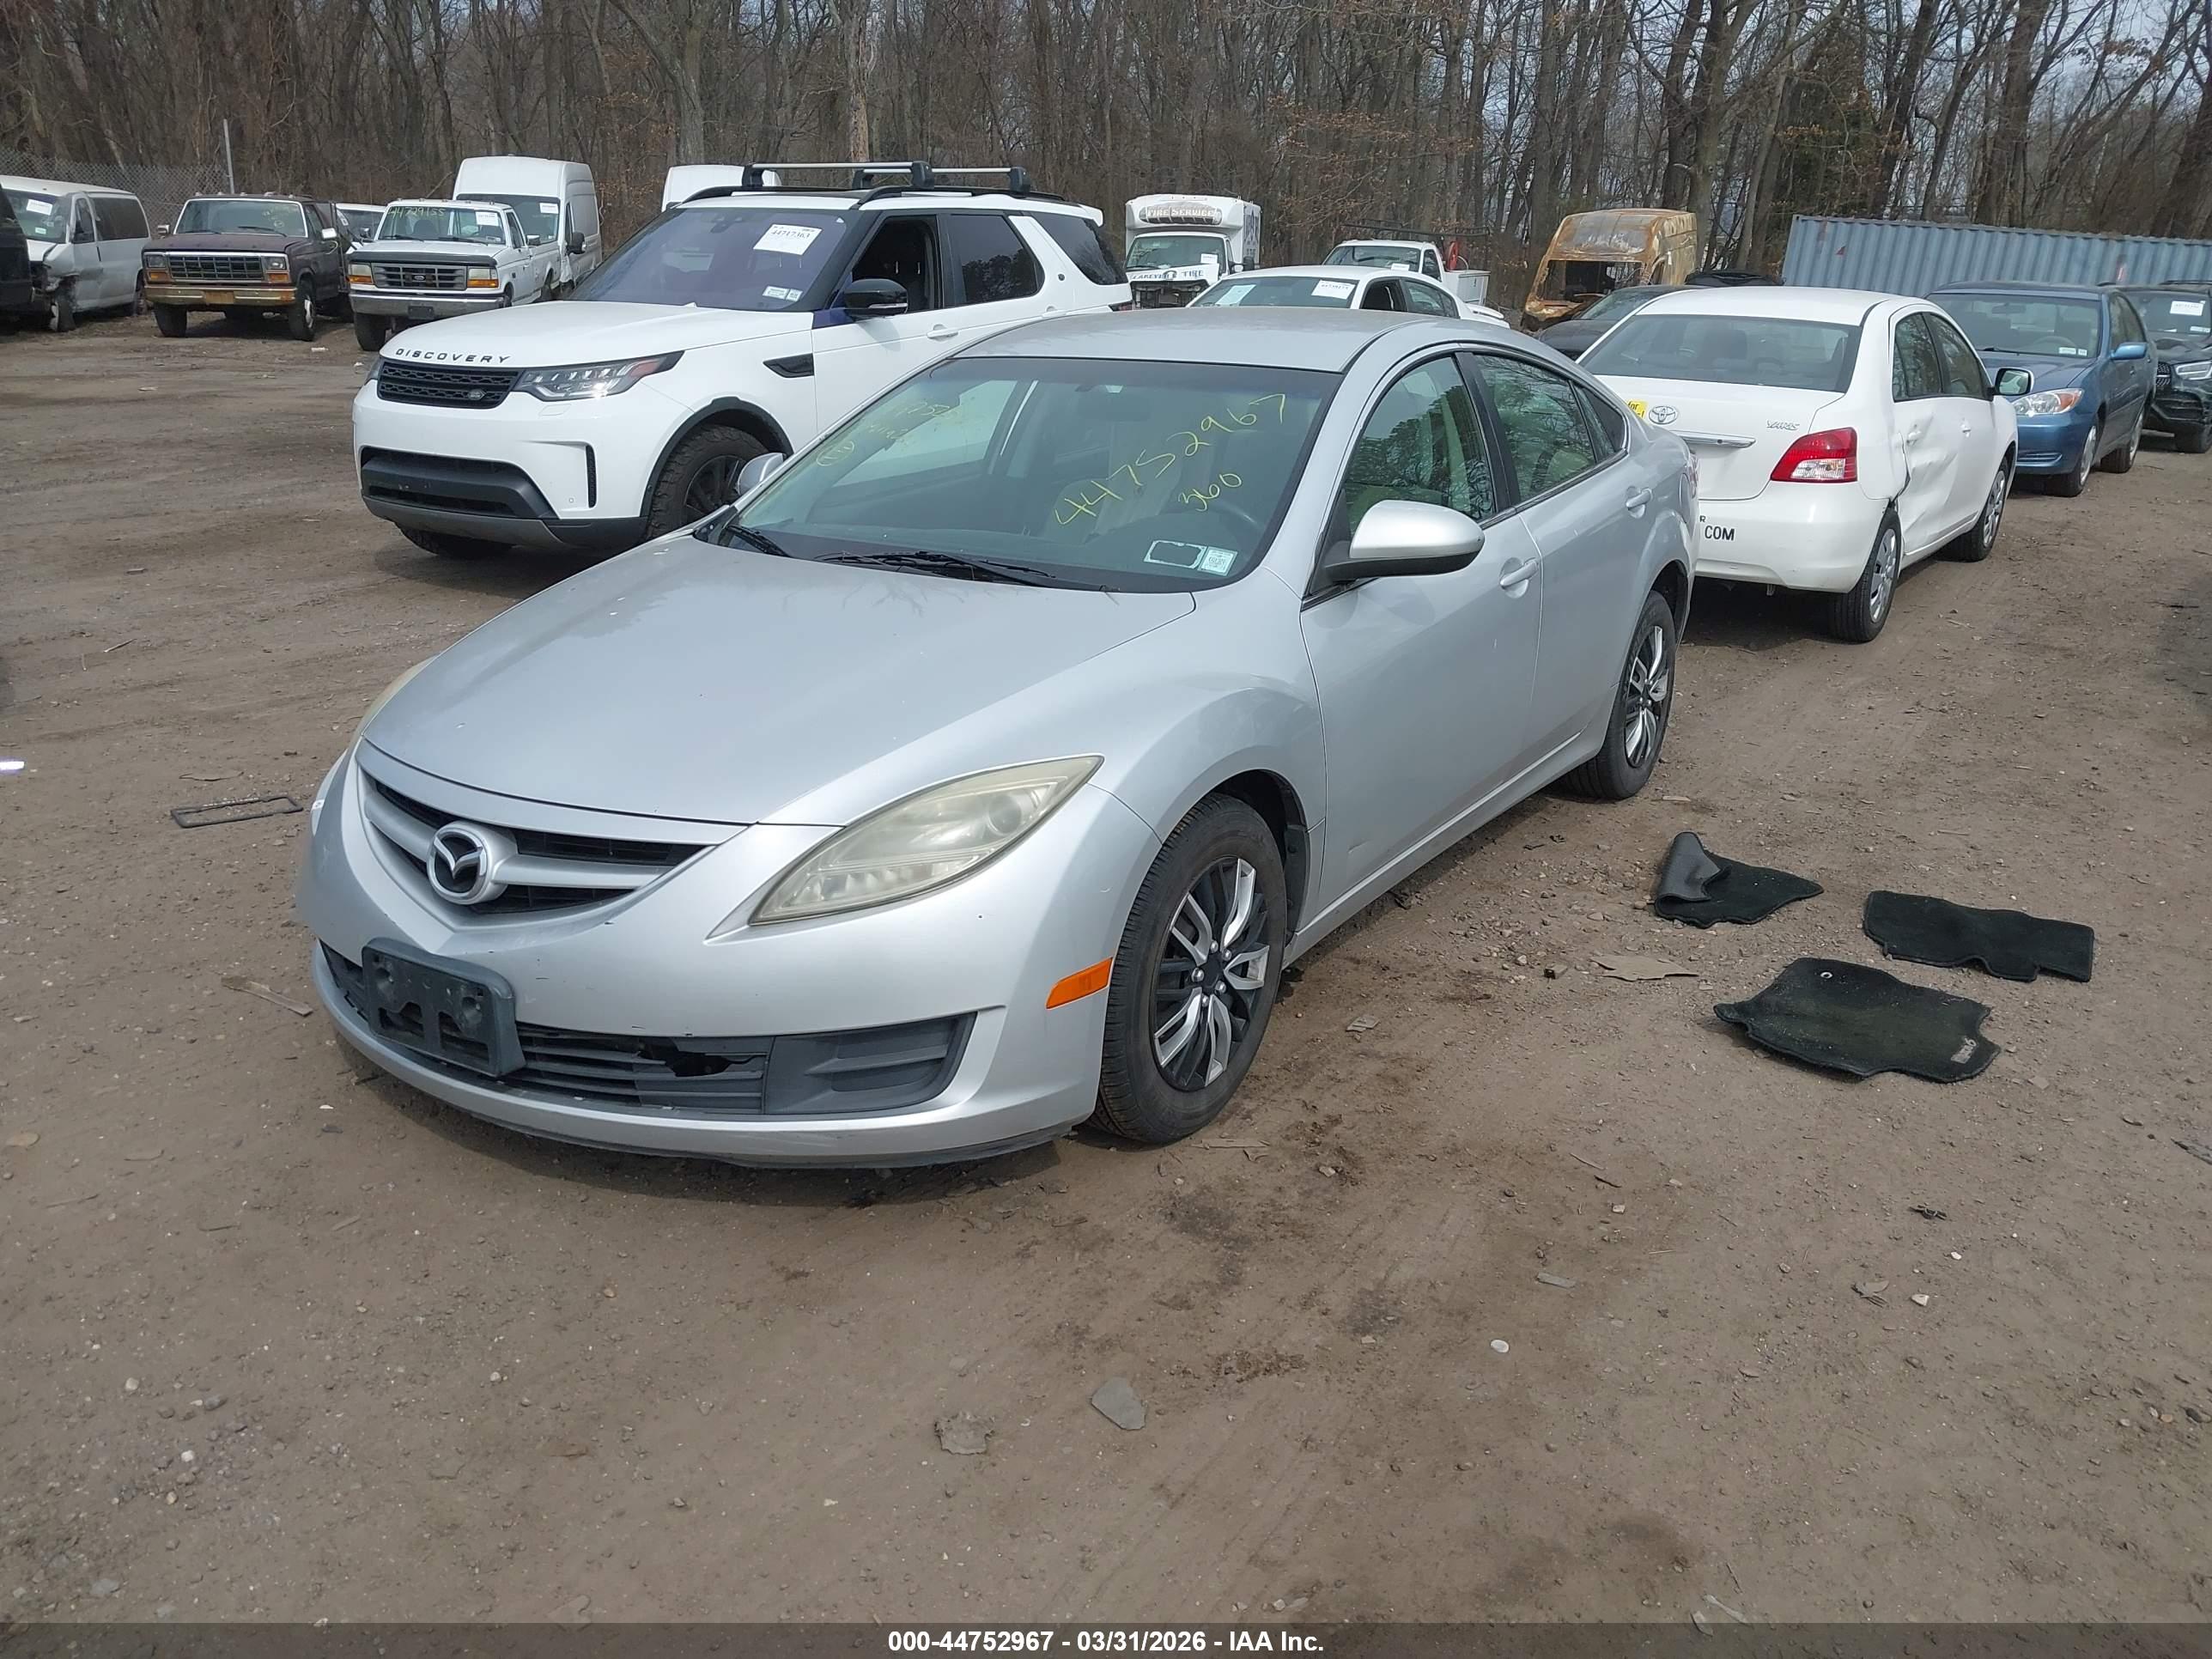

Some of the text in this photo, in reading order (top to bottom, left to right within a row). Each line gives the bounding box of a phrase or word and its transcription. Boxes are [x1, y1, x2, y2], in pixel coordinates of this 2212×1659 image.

[1171, 208, 1214, 216] SERVICE
[395, 348, 512, 363] DISCOVERY
[1054, 393, 1286, 525] 44752967
[1705, 526, 1735, 541] COM
